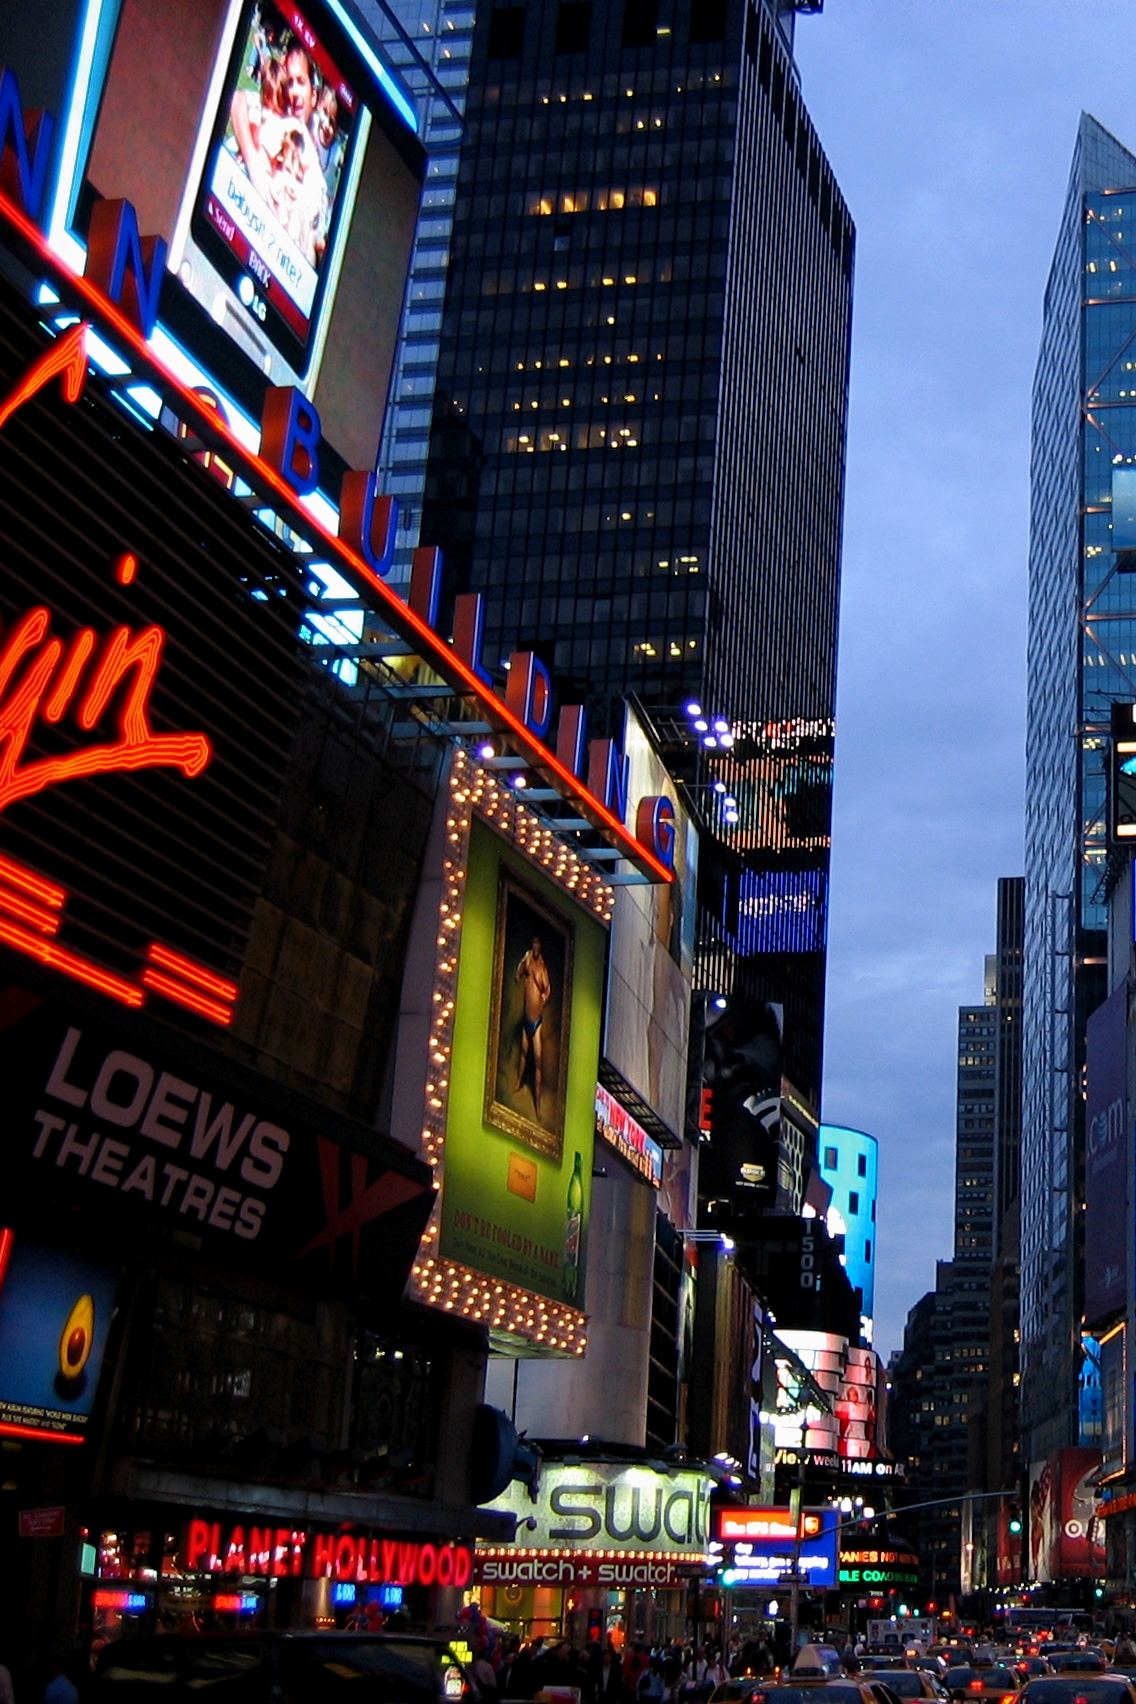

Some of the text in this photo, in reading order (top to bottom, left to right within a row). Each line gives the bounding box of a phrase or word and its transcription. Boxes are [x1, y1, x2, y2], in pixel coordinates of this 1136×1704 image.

[251, 293, 267, 322] LG
[262, 385, 673, 868] BUILDING
[45, 1026, 290, 1190] LOEWS
[31, 1110, 267, 1240] THEATRES
[187, 1518, 305, 1578] PLANET
[312, 1533, 473, 1588] HOLLYWOOD
[483, 1560, 576, 1581] swatch
